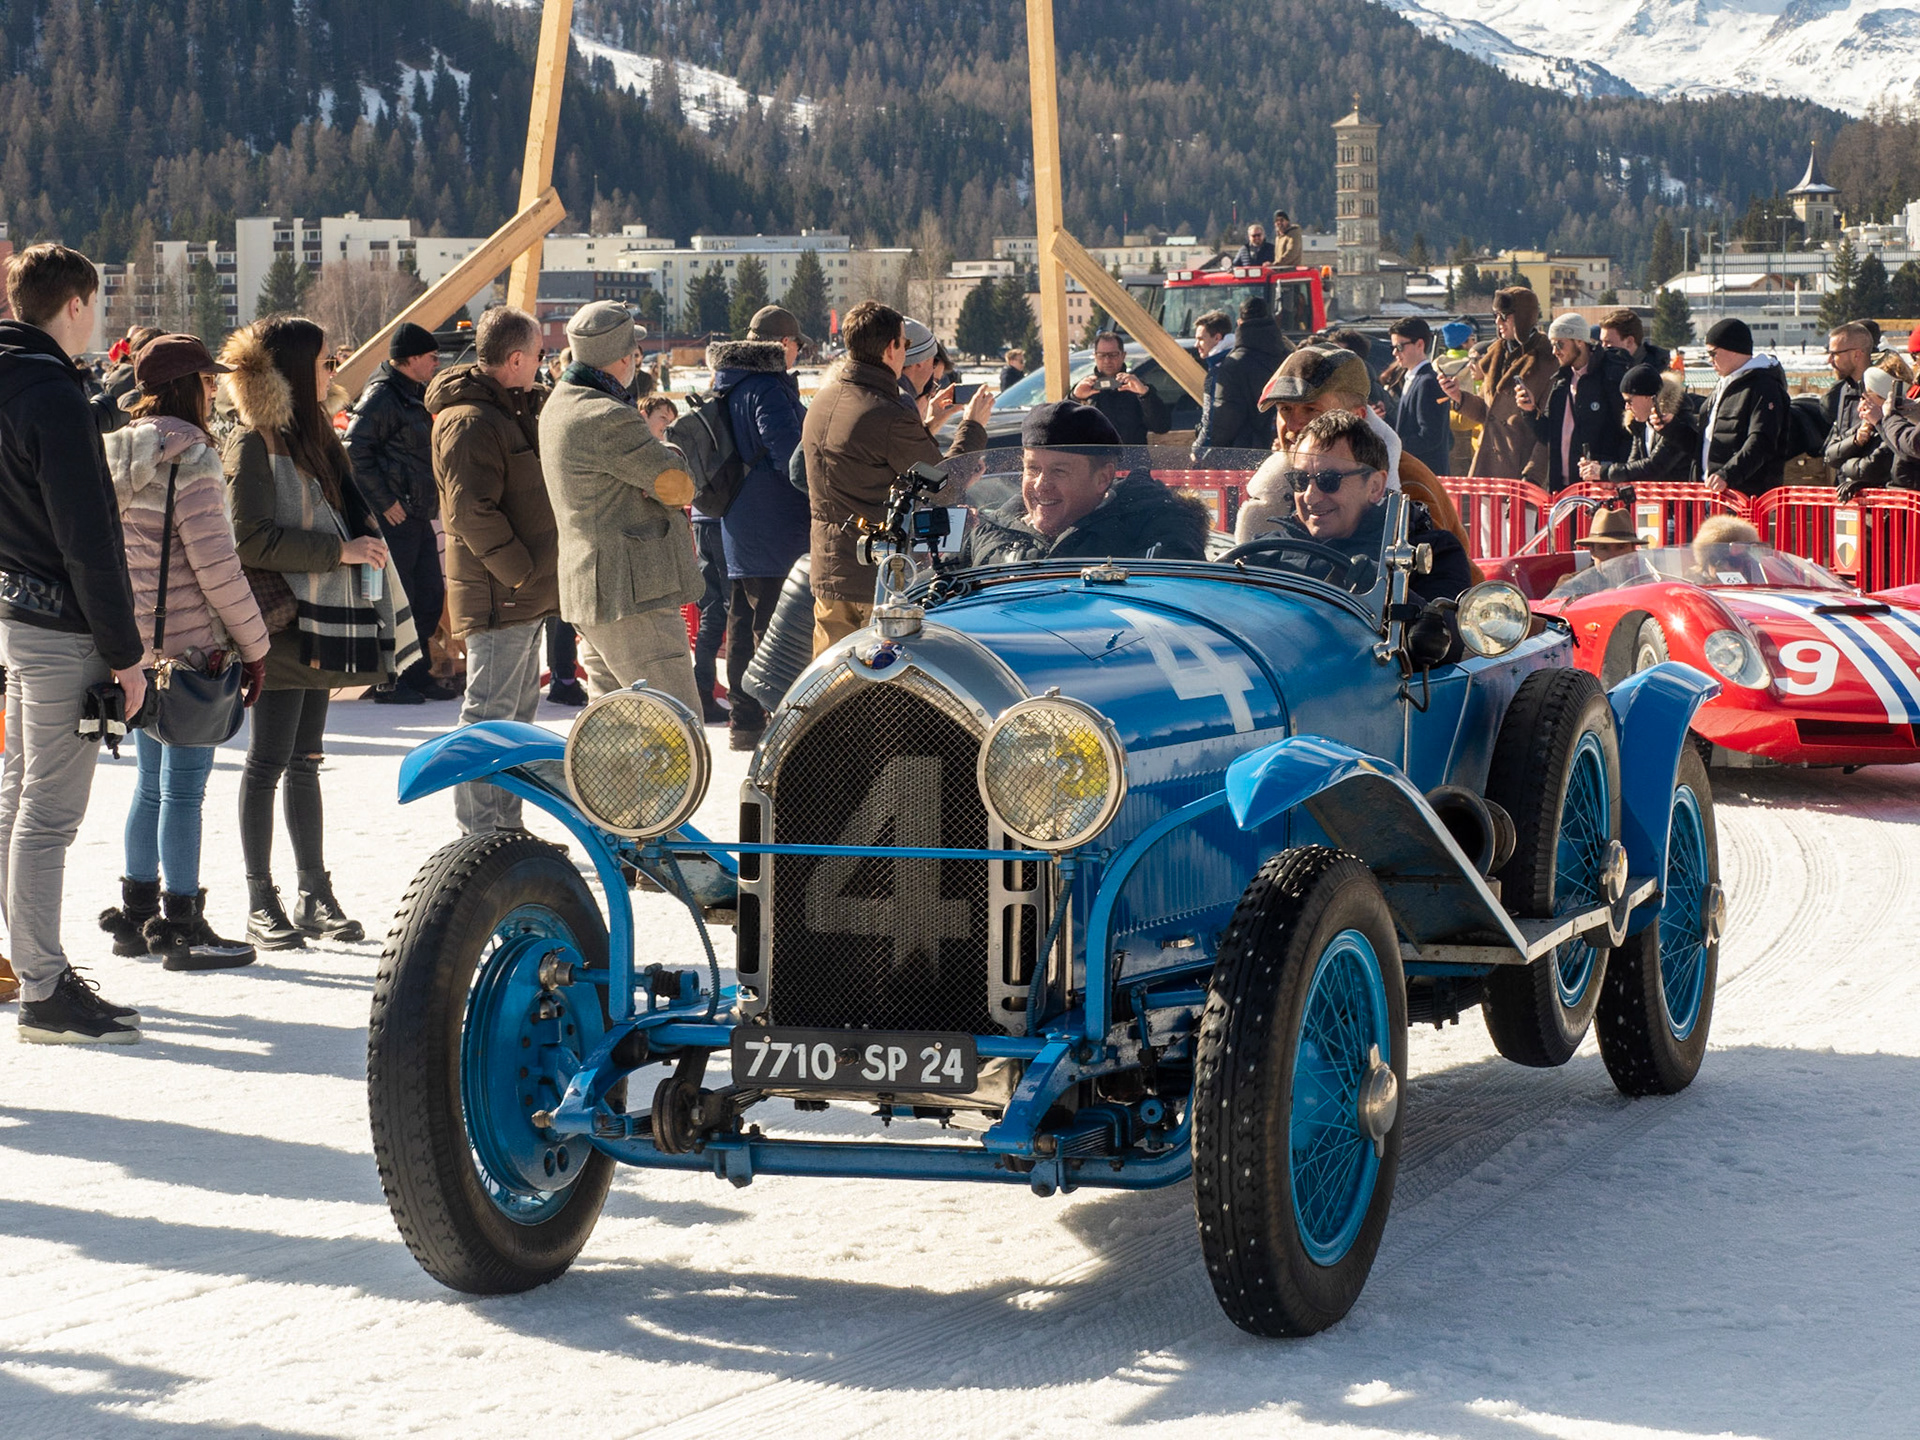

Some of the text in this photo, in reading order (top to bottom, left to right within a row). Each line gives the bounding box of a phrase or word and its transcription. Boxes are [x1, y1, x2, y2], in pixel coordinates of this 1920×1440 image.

[1111, 608, 1255, 733] 4
[1774, 640, 1840, 696] 9
[805, 754, 971, 974] 4
[745, 1041, 964, 1084] 7710 SP 24
